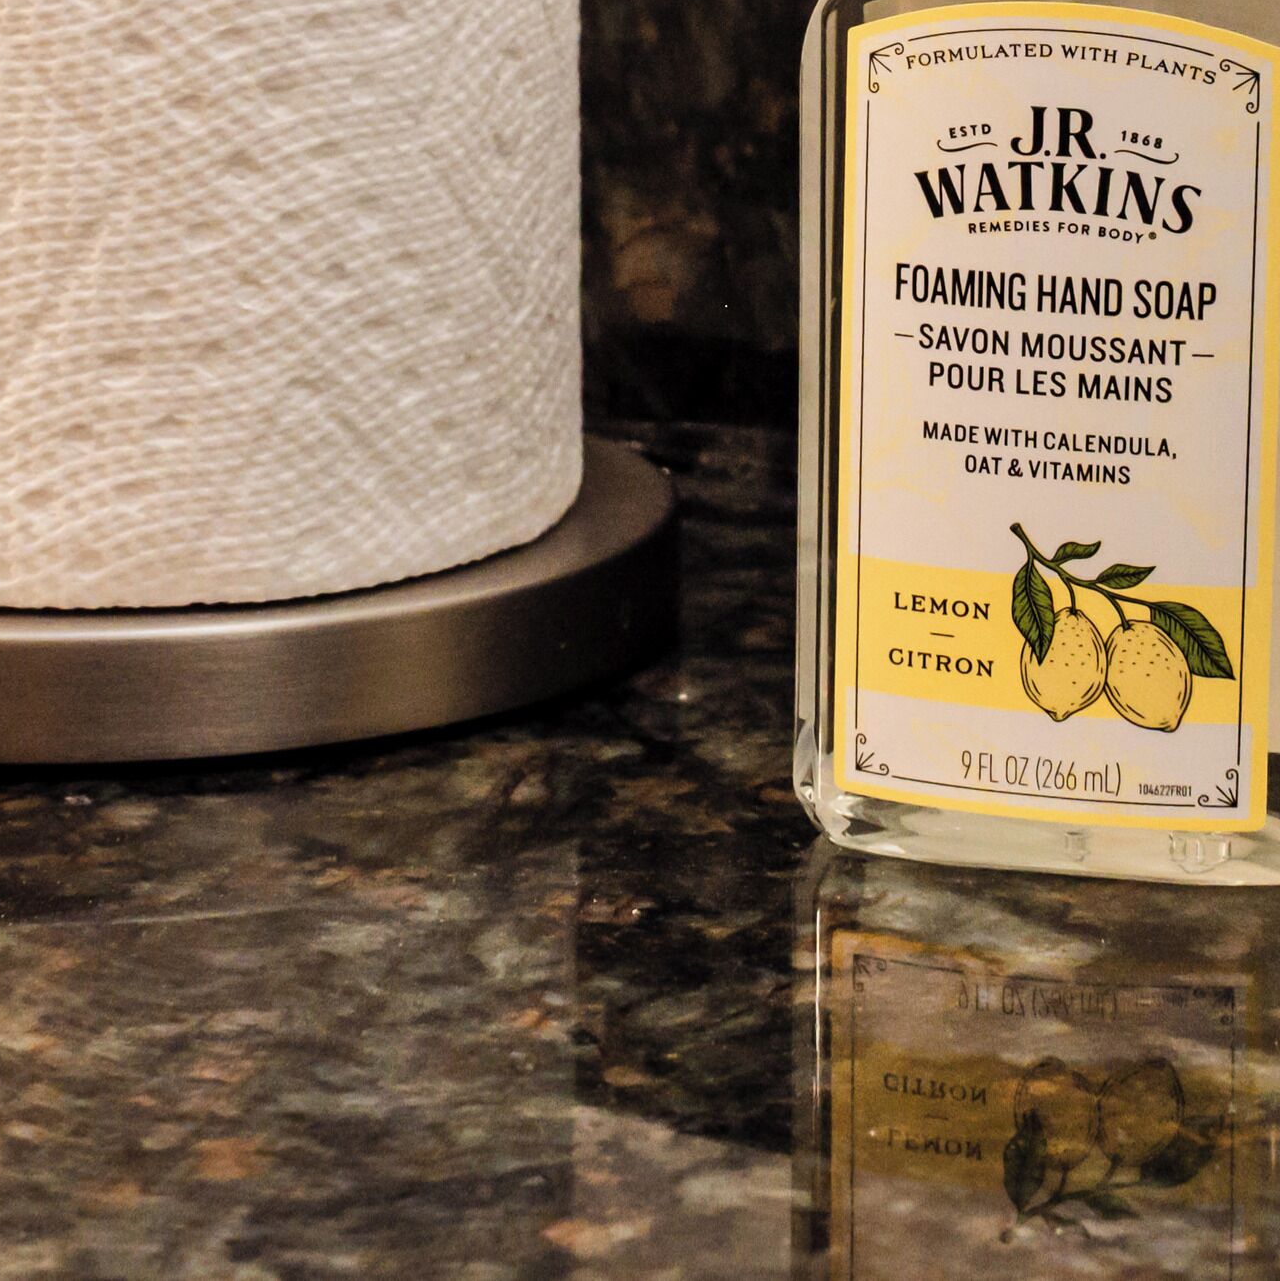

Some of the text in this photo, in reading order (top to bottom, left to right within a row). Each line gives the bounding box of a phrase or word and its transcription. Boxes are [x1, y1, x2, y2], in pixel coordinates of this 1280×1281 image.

[906, 44, 1216, 84] FORMULATED WITH PLANTS
[949, 124, 991, 138] ESTD
[1011, 106, 1106, 159] J.R.
[1121, 130, 1164, 150] 1868
[913, 161, 1202, 234] WATKINS
[969, 221, 1049, 233] REMEDIES
[1058, 222, 1090, 235] FOR
[896, 263, 1216, 320] FOAMING HAND SOAP
[919, 324, 1186, 365] SAVON MOUSSANT
[930, 362, 1172, 403] POUR LES MAINS
[924, 421, 1176, 459] MADE WITH CALENDULA,
[965, 455, 1130, 484] OAT & VITAMINS
[895, 592, 990, 619] LEMON
[889, 648, 993, 677] CITRON
[962, 751, 1120, 796] 9 FL OZ (266 mL)
